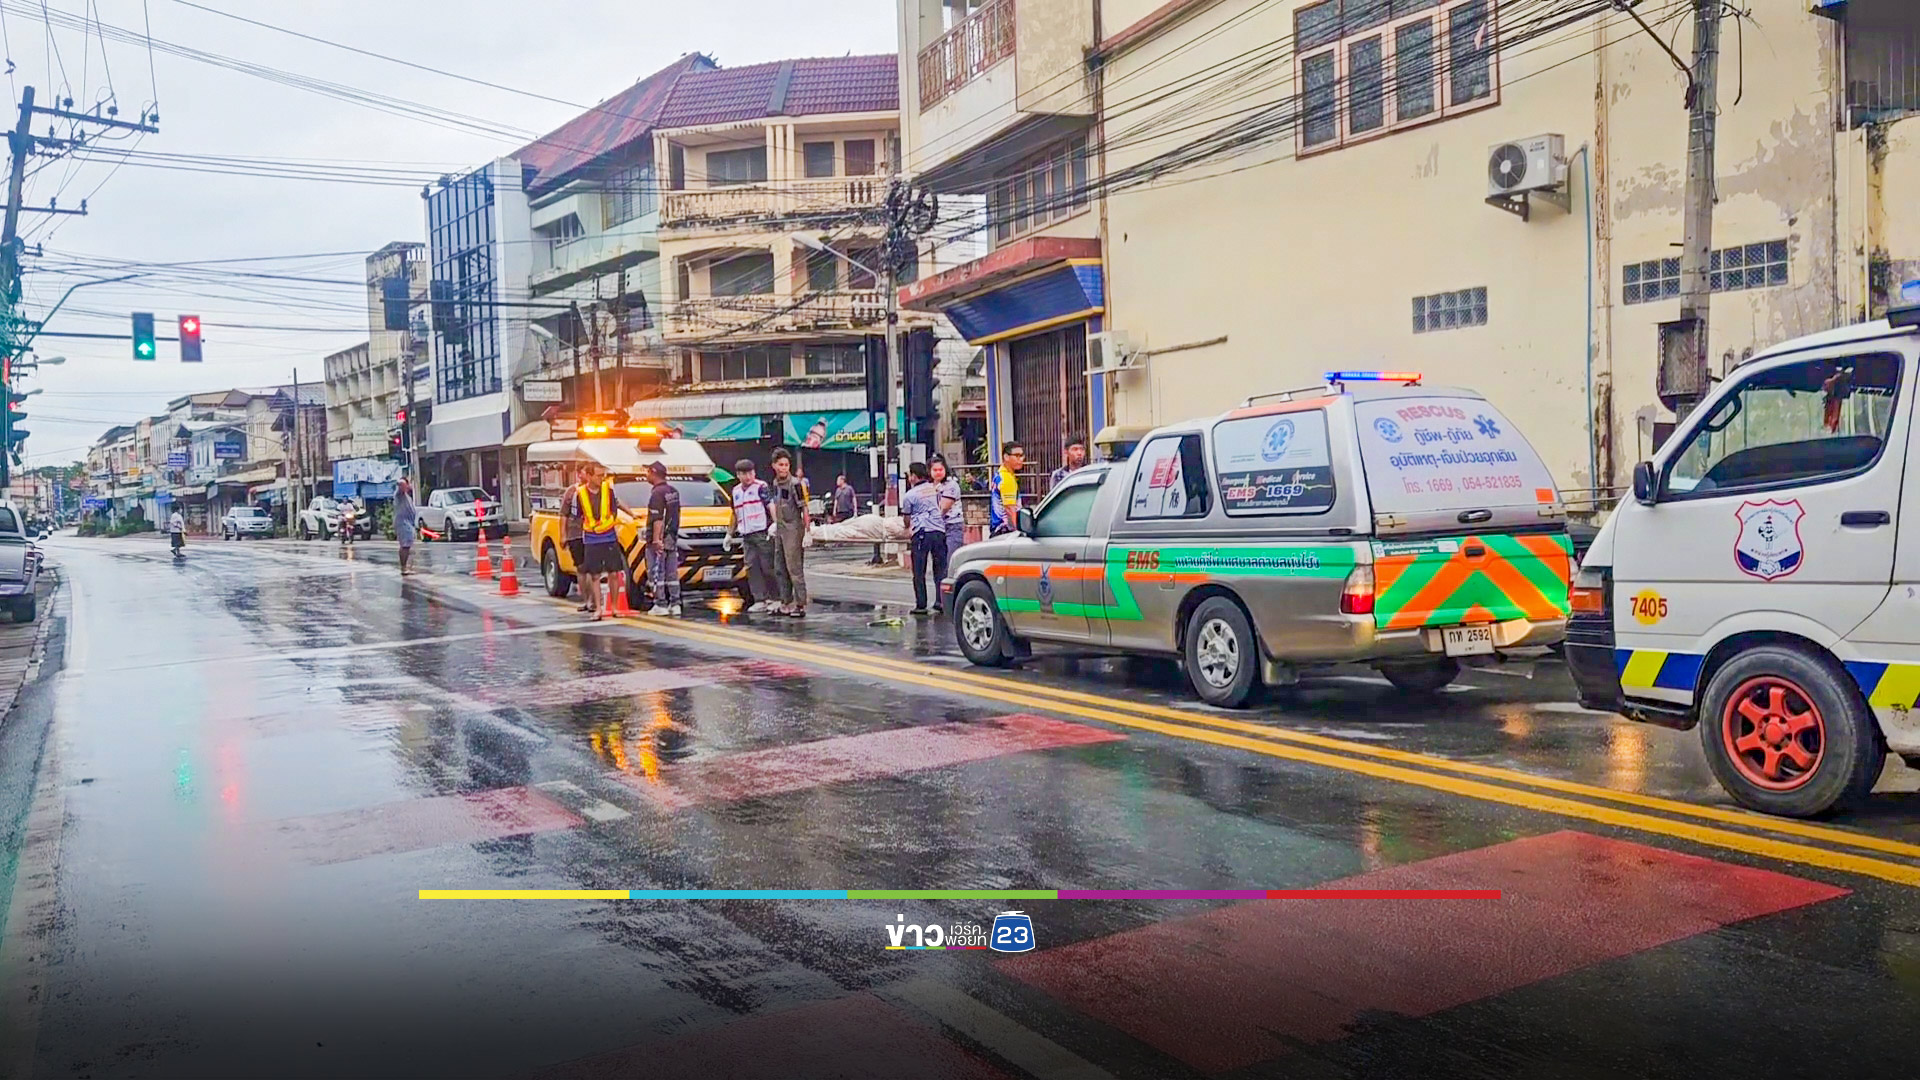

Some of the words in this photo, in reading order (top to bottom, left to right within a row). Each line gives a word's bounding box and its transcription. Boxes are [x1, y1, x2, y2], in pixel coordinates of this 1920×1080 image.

[1389, 449, 1517, 471] อุบัติเหตุ-เจ็บป่วยฉุกเฉิน
[1256, 475, 1283, 484] Medical
[1402, 477, 1424, 494] โทร.
[1427, 478, 1453, 492] 1669
[1462, 475, 1522, 491] 054-521835
[1227, 486, 1256, 500] EMS
[1266, 484, 1304, 498] 1669
[1126, 550, 1160, 569] EMS
[1630, 597, 1667, 617] 7405
[1467, 629, 1490, 642] 2592
